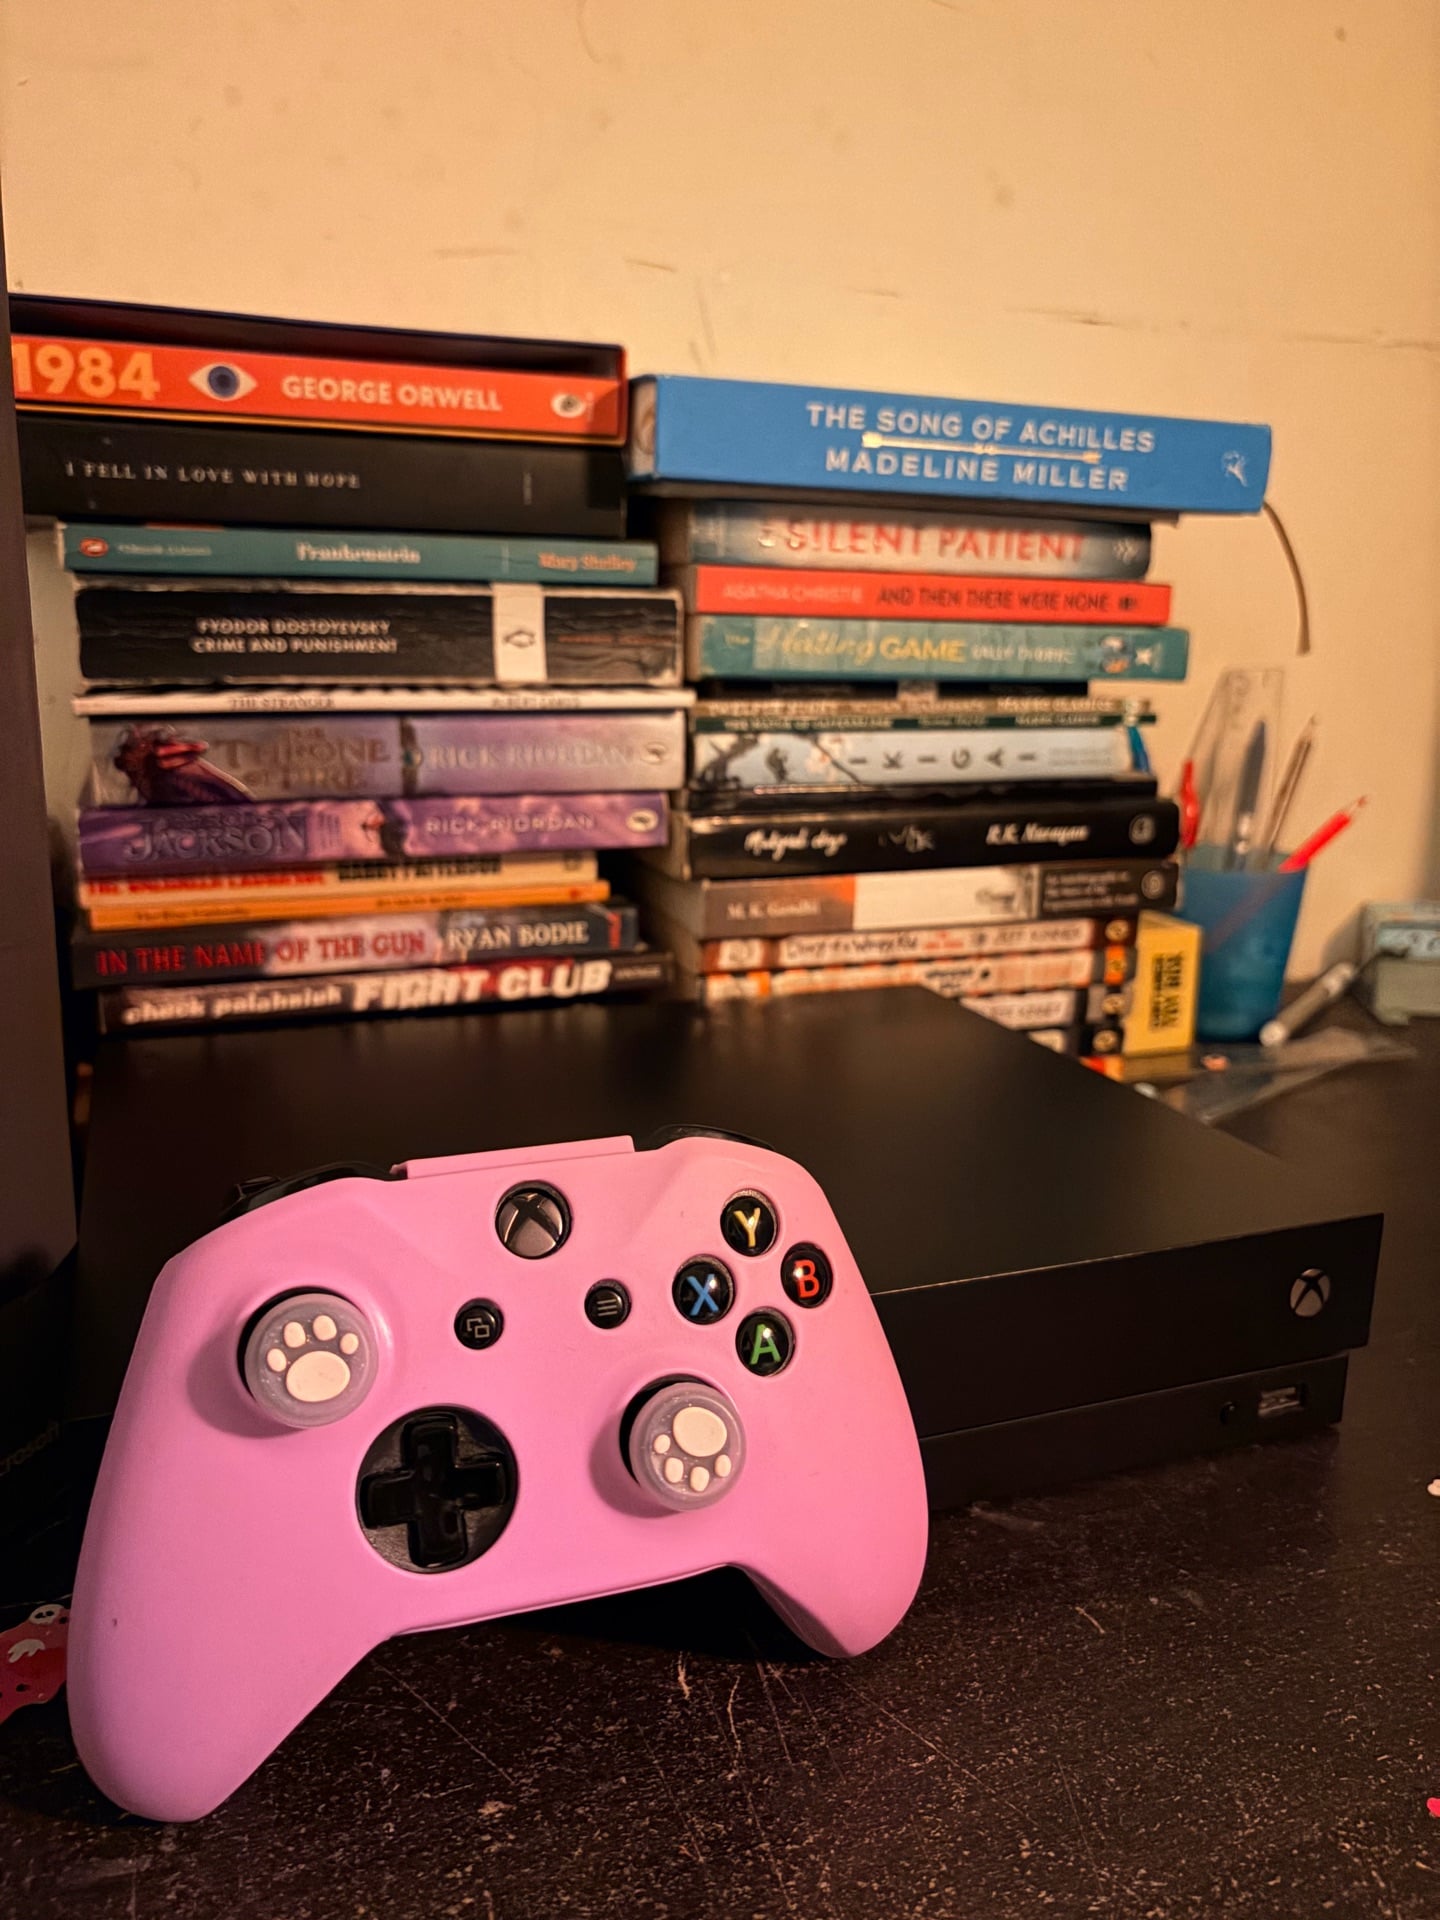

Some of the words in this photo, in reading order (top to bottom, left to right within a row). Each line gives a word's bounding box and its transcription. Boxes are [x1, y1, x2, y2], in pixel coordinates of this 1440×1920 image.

[12, 343, 161, 401] 1984
[281, 375, 391, 405] GEORGE
[398, 383, 502, 411] ORWELL
[806, 403, 866, 430] THE
[877, 408, 961, 437] SONG
[971, 415, 1012, 441] OF
[1019, 421, 1155, 452] ACHILLES
[65, 461, 74, 477] I
[83, 461, 136, 480] FELL
[144, 464, 168, 480] IN
[177, 465, 234, 484] LOVE
[241, 468, 297, 486] WITH
[305, 470, 361, 489] HOPE
[825, 448, 998, 481] MADELINE
[1012, 460, 1129, 491] MILLER
[296, 541, 421, 564] Frankenstein
[787, 521, 921, 553] SILENT
[939, 525, 1085, 563] PATIENT
[879, 587, 914, 605] AND
[918, 587, 961, 607] THEN
[967, 589, 1014, 609] THERE
[1019, 591, 1059, 610] WERE
[1063, 593, 1108, 612] NONE
[191, 636, 246, 653] CRIME
[250, 636, 288, 653] AND
[196, 617, 269, 635] FYODOR
[879, 633, 966, 663] GAME
[430, 745, 500, 770] RICK
[125, 810, 306, 861] JACKSON
[426, 815, 483, 836] RICK
[490, 814, 596, 834] RIORDAN
[96, 950, 128, 976] IN
[135, 946, 186, 973] THE
[195, 941, 266, 968] NAME
[276, 938, 310, 963] OF
[317, 933, 364, 959] THE
[372, 931, 425, 957] GUN
[449, 924, 511, 951] RYAN
[518, 921, 590, 947] BODIE
[122, 998, 206, 1026] chuck
[353, 969, 491, 1011] FIGHT
[498, 960, 612, 1000] CLUB
[734, 1207, 761, 1248] Y
[686, 1272, 720, 1317] X
[794, 1259, 821, 1300] B
[749, 1322, 782, 1365] A
